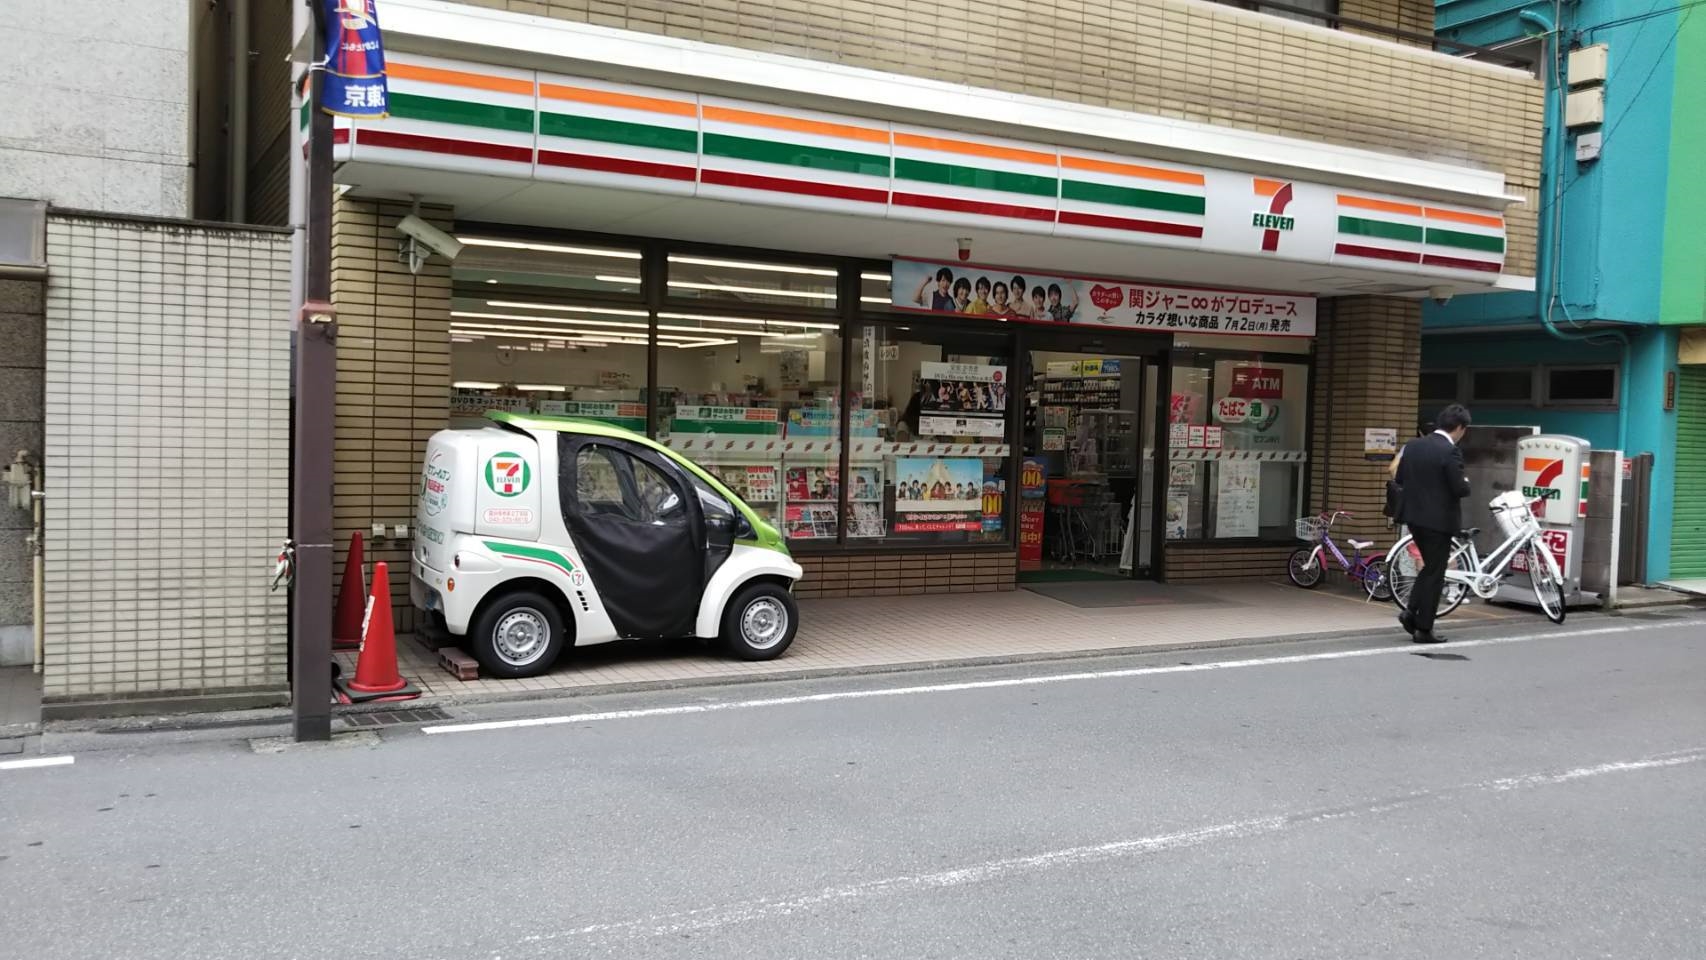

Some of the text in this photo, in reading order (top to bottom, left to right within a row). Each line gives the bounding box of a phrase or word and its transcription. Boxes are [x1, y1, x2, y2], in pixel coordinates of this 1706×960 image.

[1253, 177, 1293, 251] 7
[1129, 288, 1297, 316] 関ジャニ∞がプロデュース
[1136, 311, 1219, 329] カラダ想いな商品
[1252, 377, 1280, 391] ATM
[1219, 401, 1262, 417] たばこ 酒
[496, 462, 519, 493] 7
[1523, 457, 1564, 518] 7
